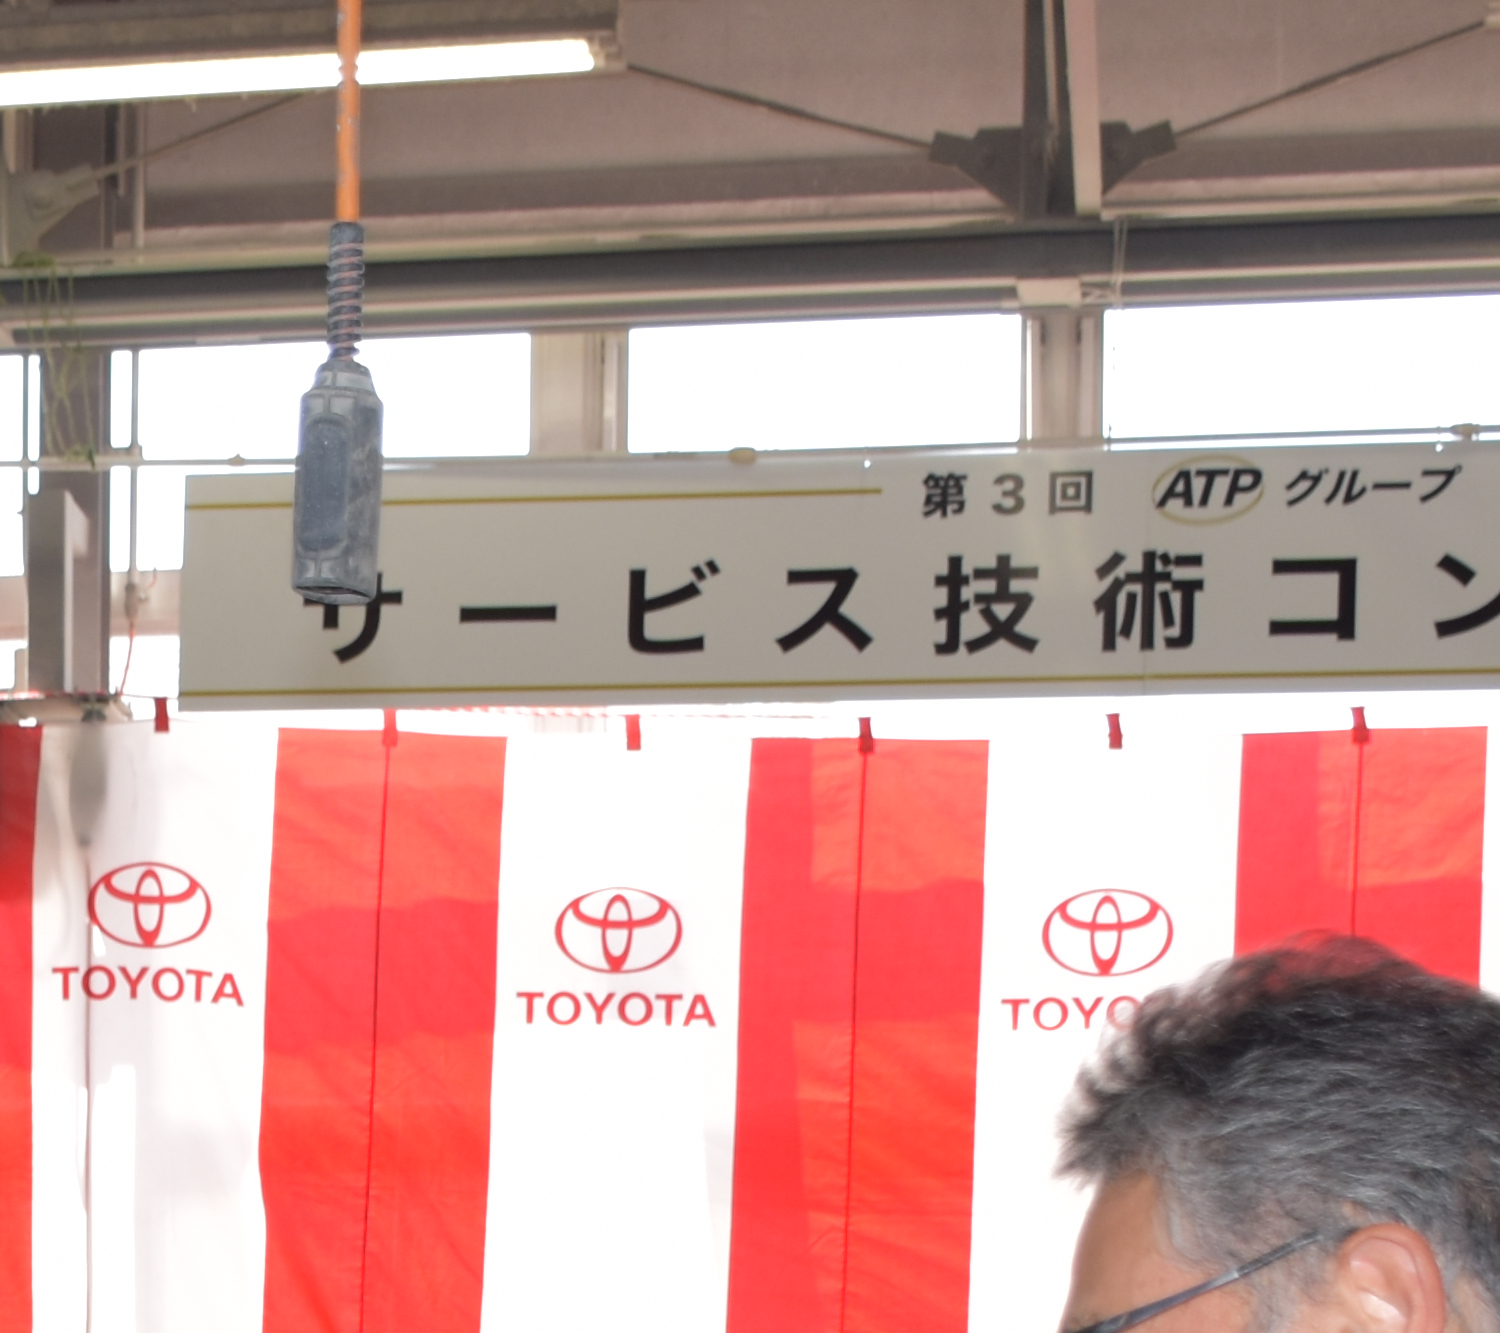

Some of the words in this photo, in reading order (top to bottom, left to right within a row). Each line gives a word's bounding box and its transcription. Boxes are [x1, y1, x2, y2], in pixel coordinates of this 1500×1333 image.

[1157, 468, 1264, 508] ATP
[1284, 465, 1464, 507] グループ
[52, 963, 245, 1007] TOYOTA
[516, 990, 717, 1028] TOYOTA
